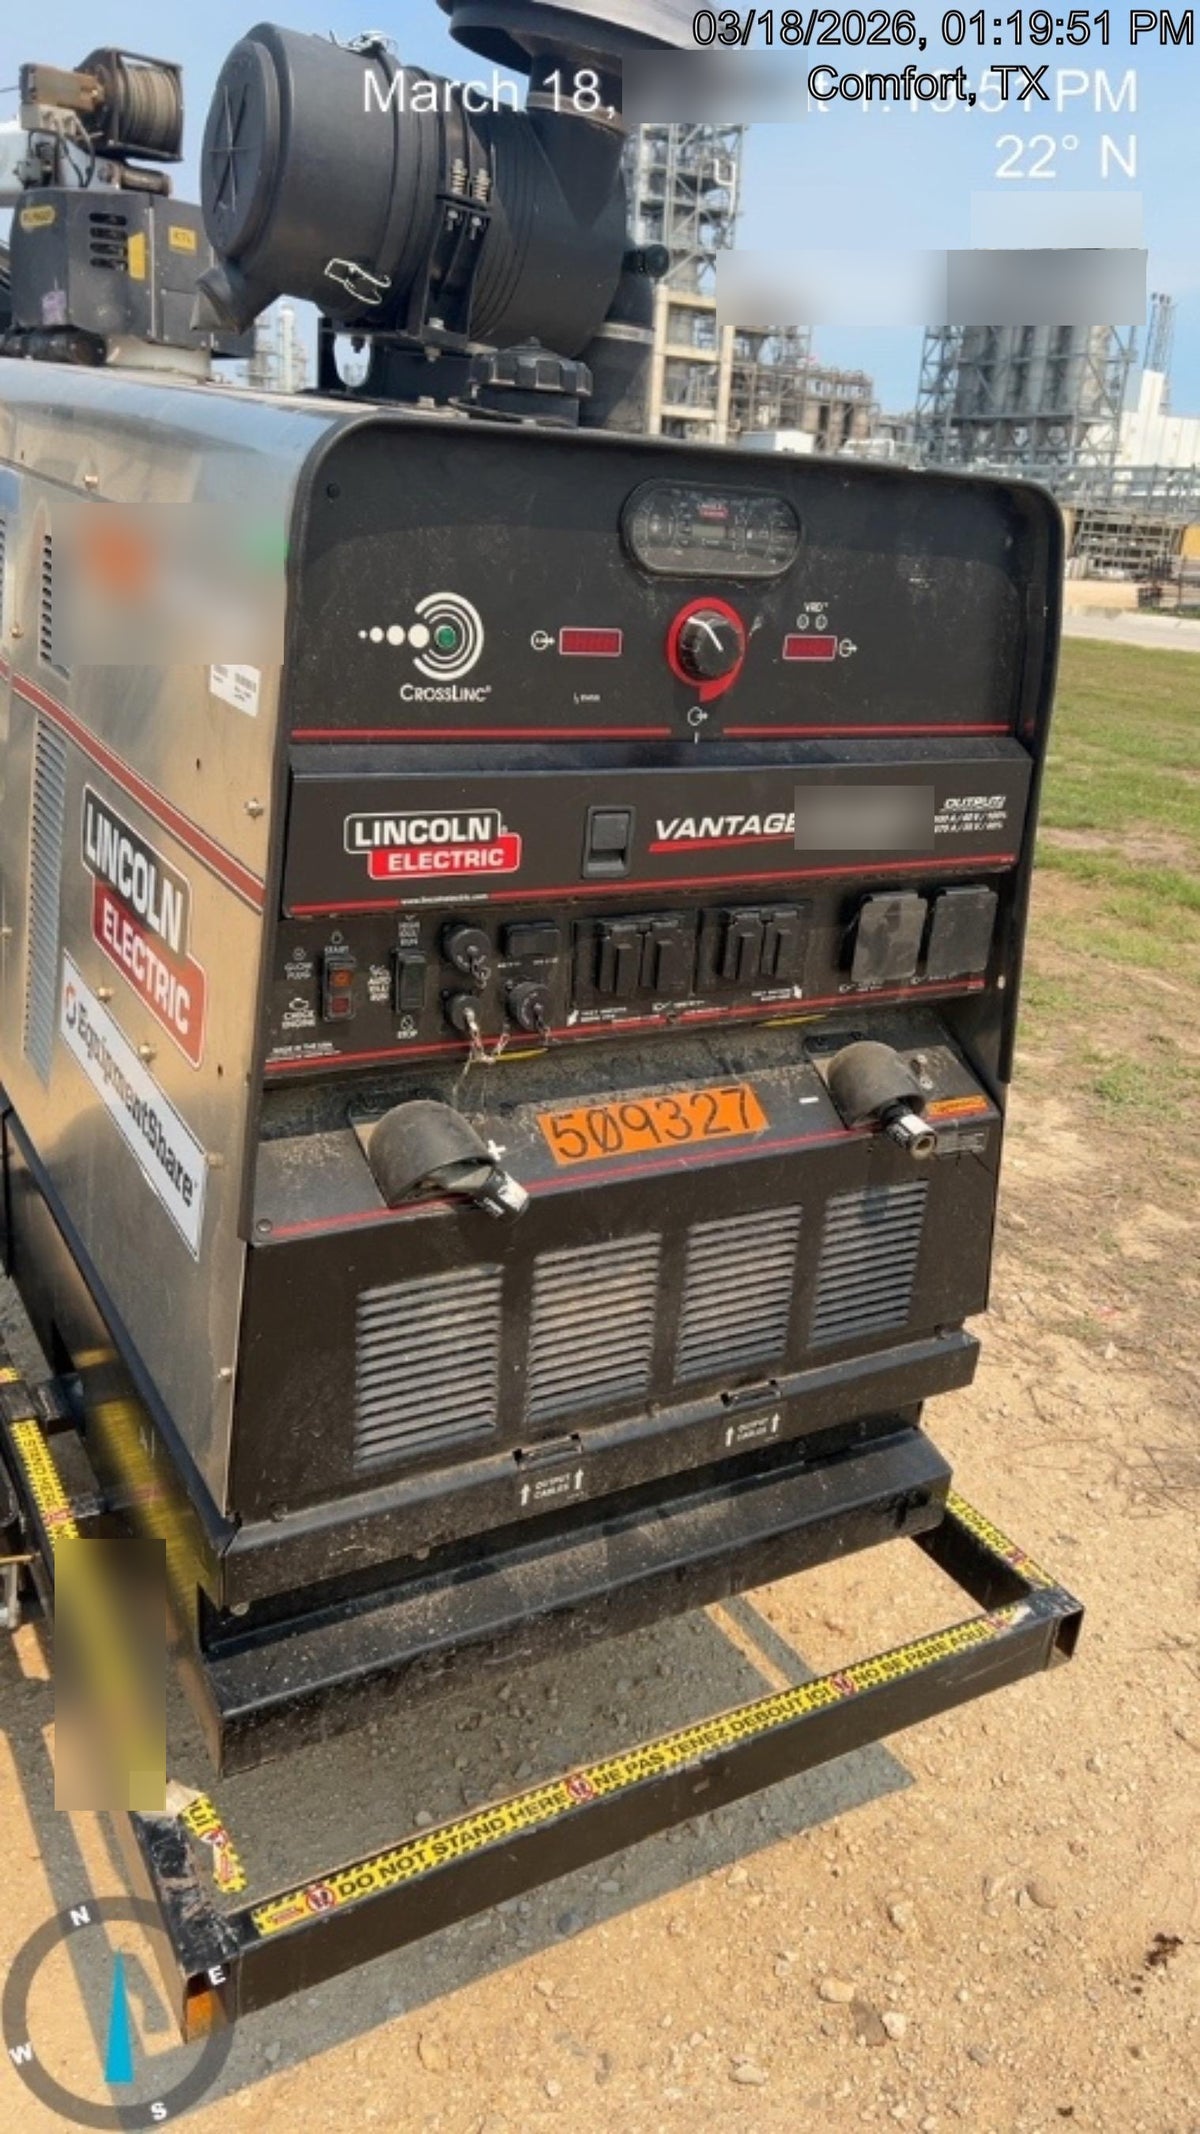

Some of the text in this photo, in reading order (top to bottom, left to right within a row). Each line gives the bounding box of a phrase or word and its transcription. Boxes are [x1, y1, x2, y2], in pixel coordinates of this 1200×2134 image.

[354, 816, 492, 848] LINCOLN
[387, 848, 505, 873] ELECTRIC
[656, 812, 795, 840] VANTAGE
[84, 802, 185, 954] LINCOLN
[102, 896, 192, 1035] ELECTRIC
[551, 1087, 751, 1160] 509327
[852, 1666, 880, 1685] NO
[904, 1642, 948, 1665] PARE
[592, 1687, 831, 1788] NE PAS TENEZ DEBOUT ICI
[339, 1788, 568, 1897] DO NOT STAND HERE
